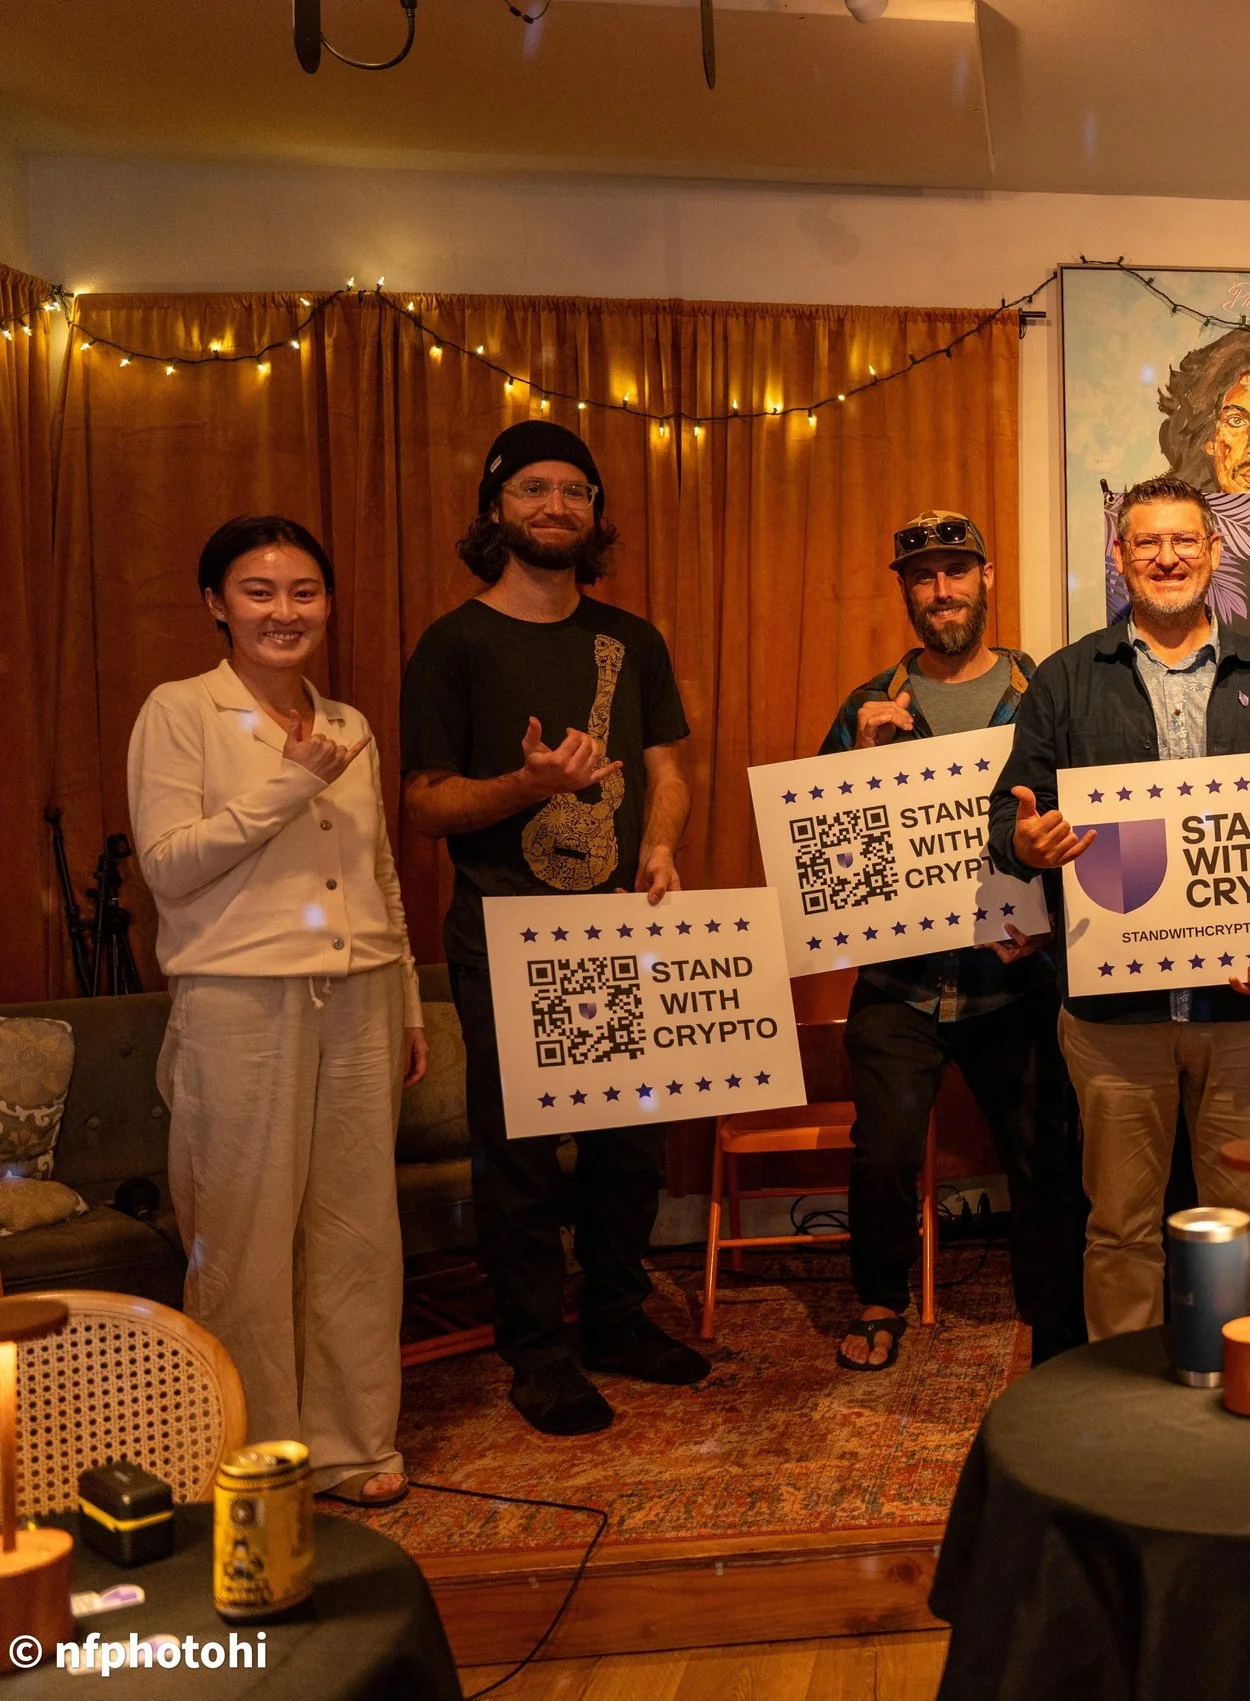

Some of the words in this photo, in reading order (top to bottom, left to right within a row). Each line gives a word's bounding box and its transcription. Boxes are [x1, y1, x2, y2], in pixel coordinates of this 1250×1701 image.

[900, 795, 991, 829] STAND
[909, 827, 984, 858] WITH
[651, 956, 753, 983] STAND
[659, 988, 740, 1015] WITH
[653, 1017, 778, 1049] CRYPTO
